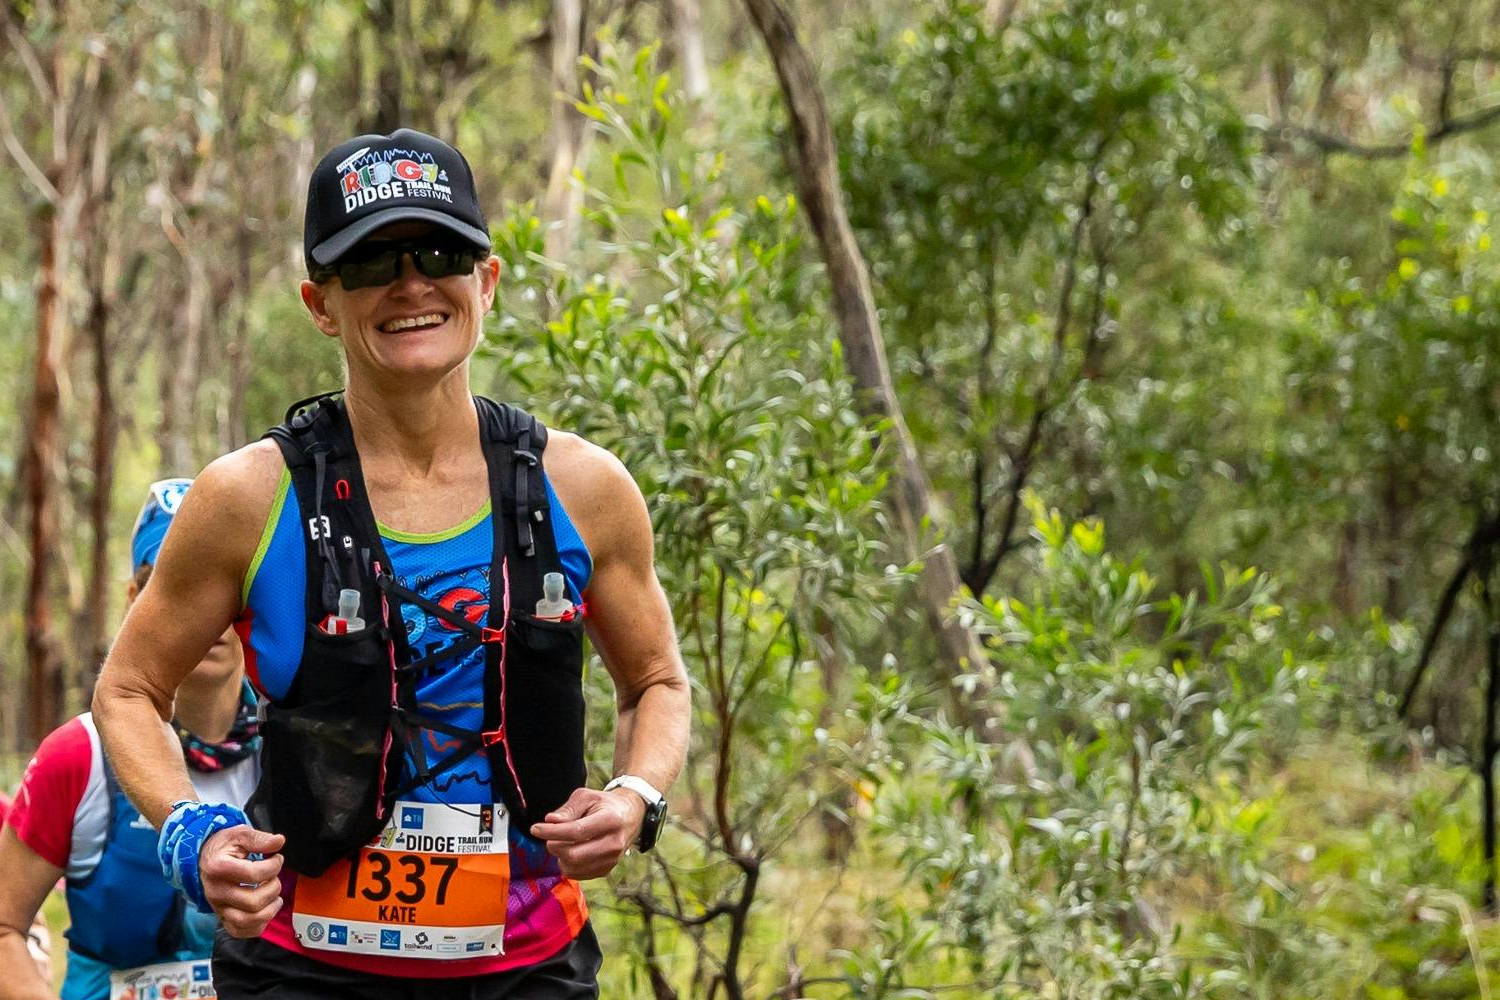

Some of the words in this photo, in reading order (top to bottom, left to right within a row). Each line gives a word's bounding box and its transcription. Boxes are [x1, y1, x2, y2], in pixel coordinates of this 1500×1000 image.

[405, 181, 433, 190] TRAIL
[345, 182, 404, 213] DIDGE
[407, 188, 453, 203] FESTIVAL
[406, 834, 455, 853] DIDGE
[457, 836, 478, 845] TRAIL
[478, 837, 493, 845] RUN
[457, 844, 492, 853] FESTIVAL
[346, 852, 459, 905] 1337
[378, 905, 417, 924] KATE
